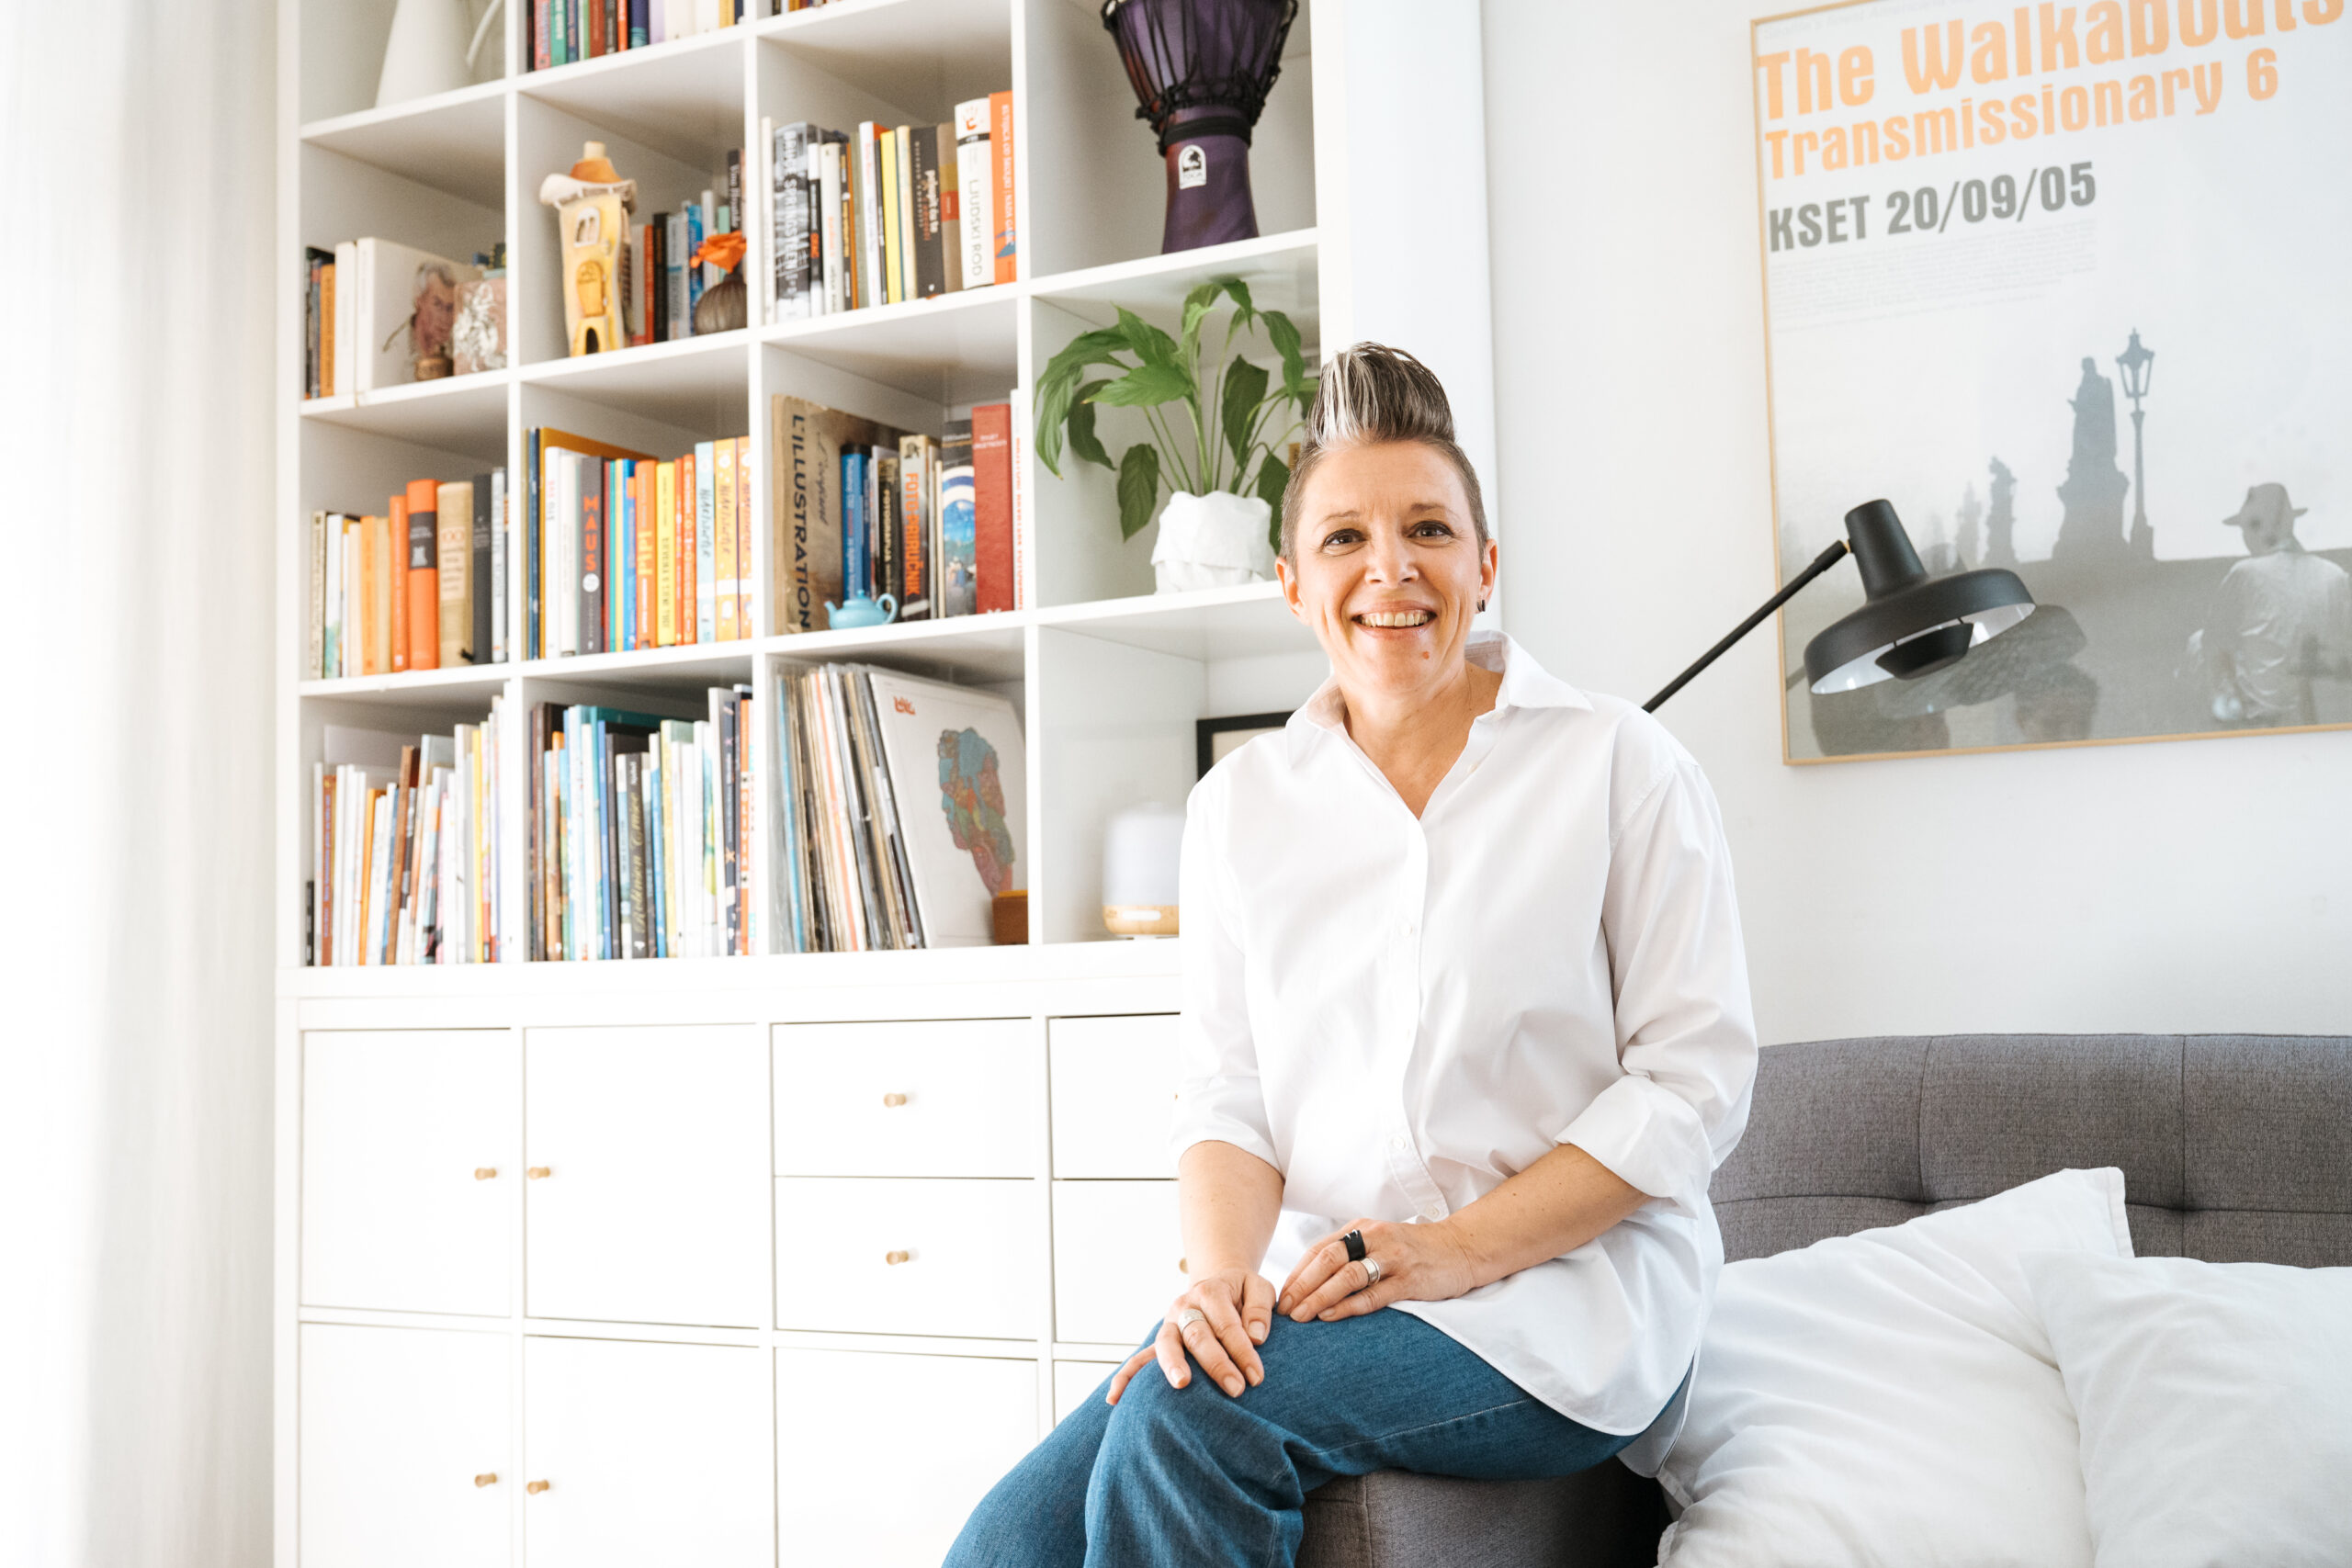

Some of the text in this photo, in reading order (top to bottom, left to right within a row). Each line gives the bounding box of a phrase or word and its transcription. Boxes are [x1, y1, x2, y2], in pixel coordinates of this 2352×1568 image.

[1757, 45, 1875, 120] The
[1765, 47, 2279, 181] Transmissionary 6
[783, 130, 798, 175] BRUCE
[783, 178, 798, 270] SPRINGSTEEN
[967, 179, 983, 276] LJUDSKI ROD
[1768, 161, 2098, 254] KSET 20/09/05
[582, 494, 599, 572] MAUS
[791, 414, 811, 629] L'ILLUSTRATION
[883, 489, 892, 562] FOTOGRAFIJA
[905, 472, 924, 596] FOTO-PRIRUČNIK
[741, 788, 750, 869] OLIVIA
